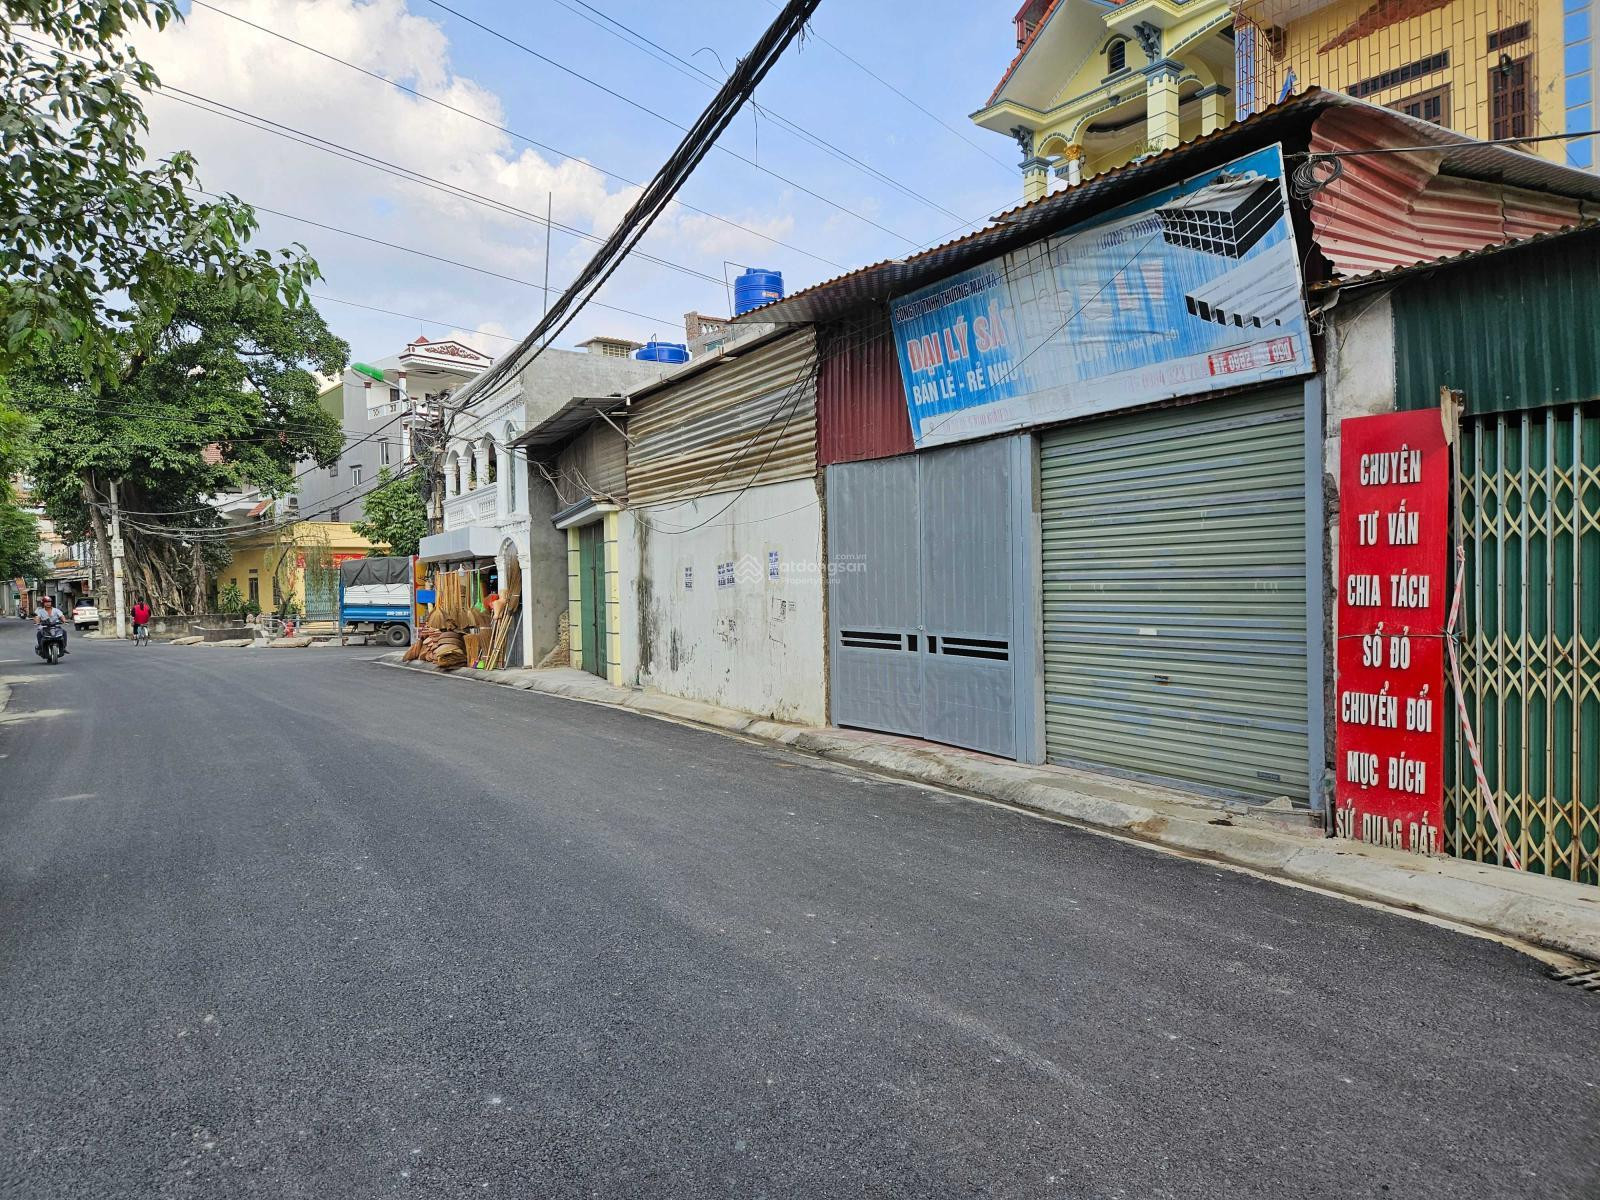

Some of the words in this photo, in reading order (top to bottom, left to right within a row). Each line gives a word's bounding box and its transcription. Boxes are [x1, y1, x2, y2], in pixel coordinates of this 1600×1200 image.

[895, 305, 913, 323] CÔNG
[907, 332, 943, 376] ĐẠI
[943, 315, 969, 363] LÝ
[912, 380, 940, 406] BÁN
[941, 369, 957, 399] LẺ
[967, 361, 986, 393] RẺ
[1360, 444, 1422, 486] CHUYÊN
[1358, 510, 1379, 546] TƯ
[1388, 499, 1419, 545] VẤN
[1347, 574, 1381, 607] CHIA
[1390, 568, 1430, 608] TÁCH
[1362, 621, 1382, 667] SỔ
[1389, 626, 1411, 670] ĐỎ
[1341, 680, 1398, 729] CHUYỂN
[1406, 684, 1432, 733] ĐỔI
[1347, 751, 1379, 790] MỤC
[1388, 752, 1426, 795] ĐÍCH
[1335, 798, 1356, 840] SỬ
